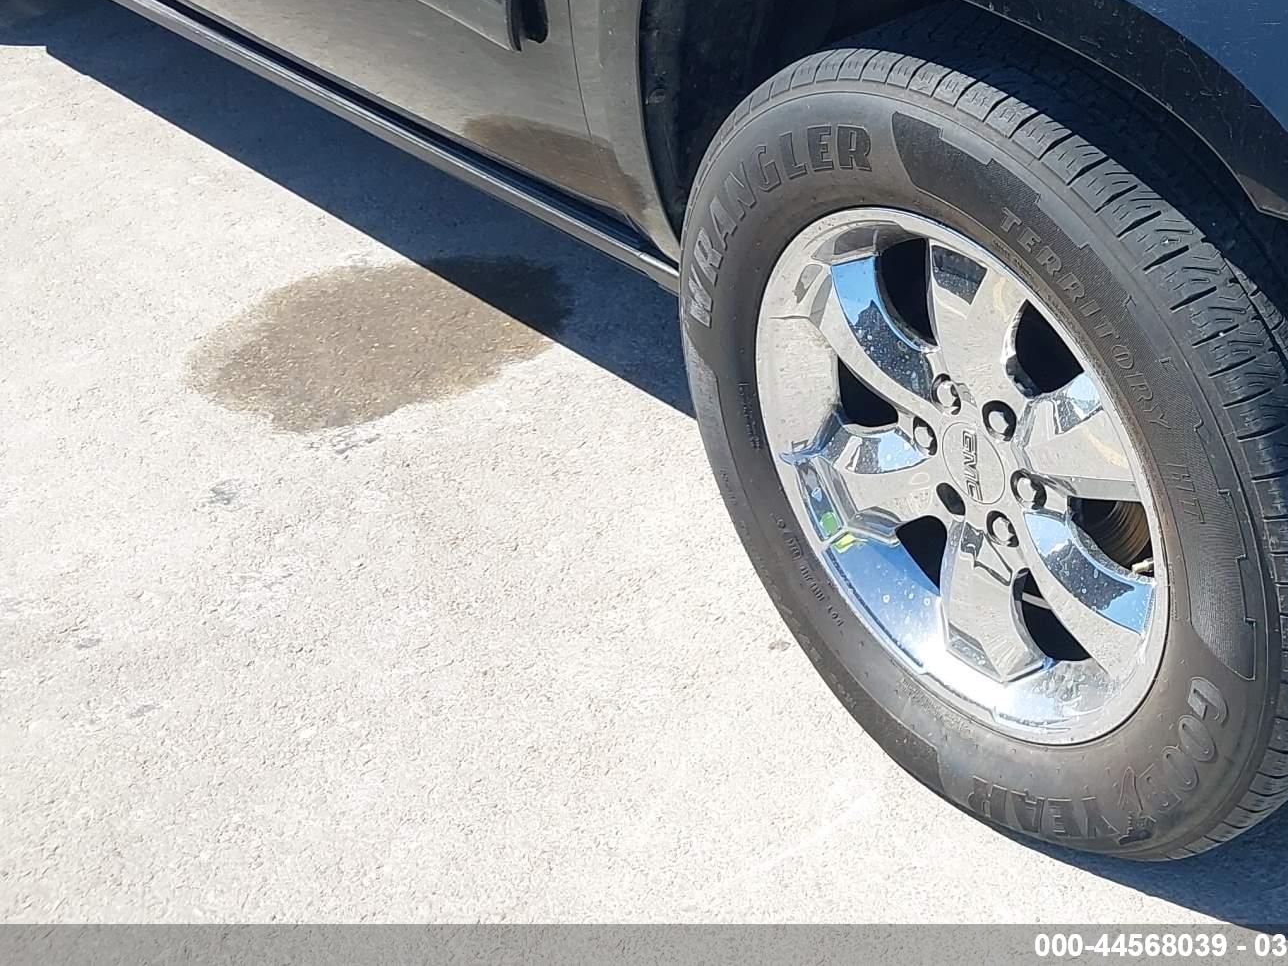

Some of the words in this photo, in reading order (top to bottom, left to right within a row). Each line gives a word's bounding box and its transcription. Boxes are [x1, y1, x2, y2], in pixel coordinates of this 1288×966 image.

[687, 124, 872, 328] WRANGLER
[999, 207, 1173, 430] TERRITORY
[962, 429, 983, 502] GMC
